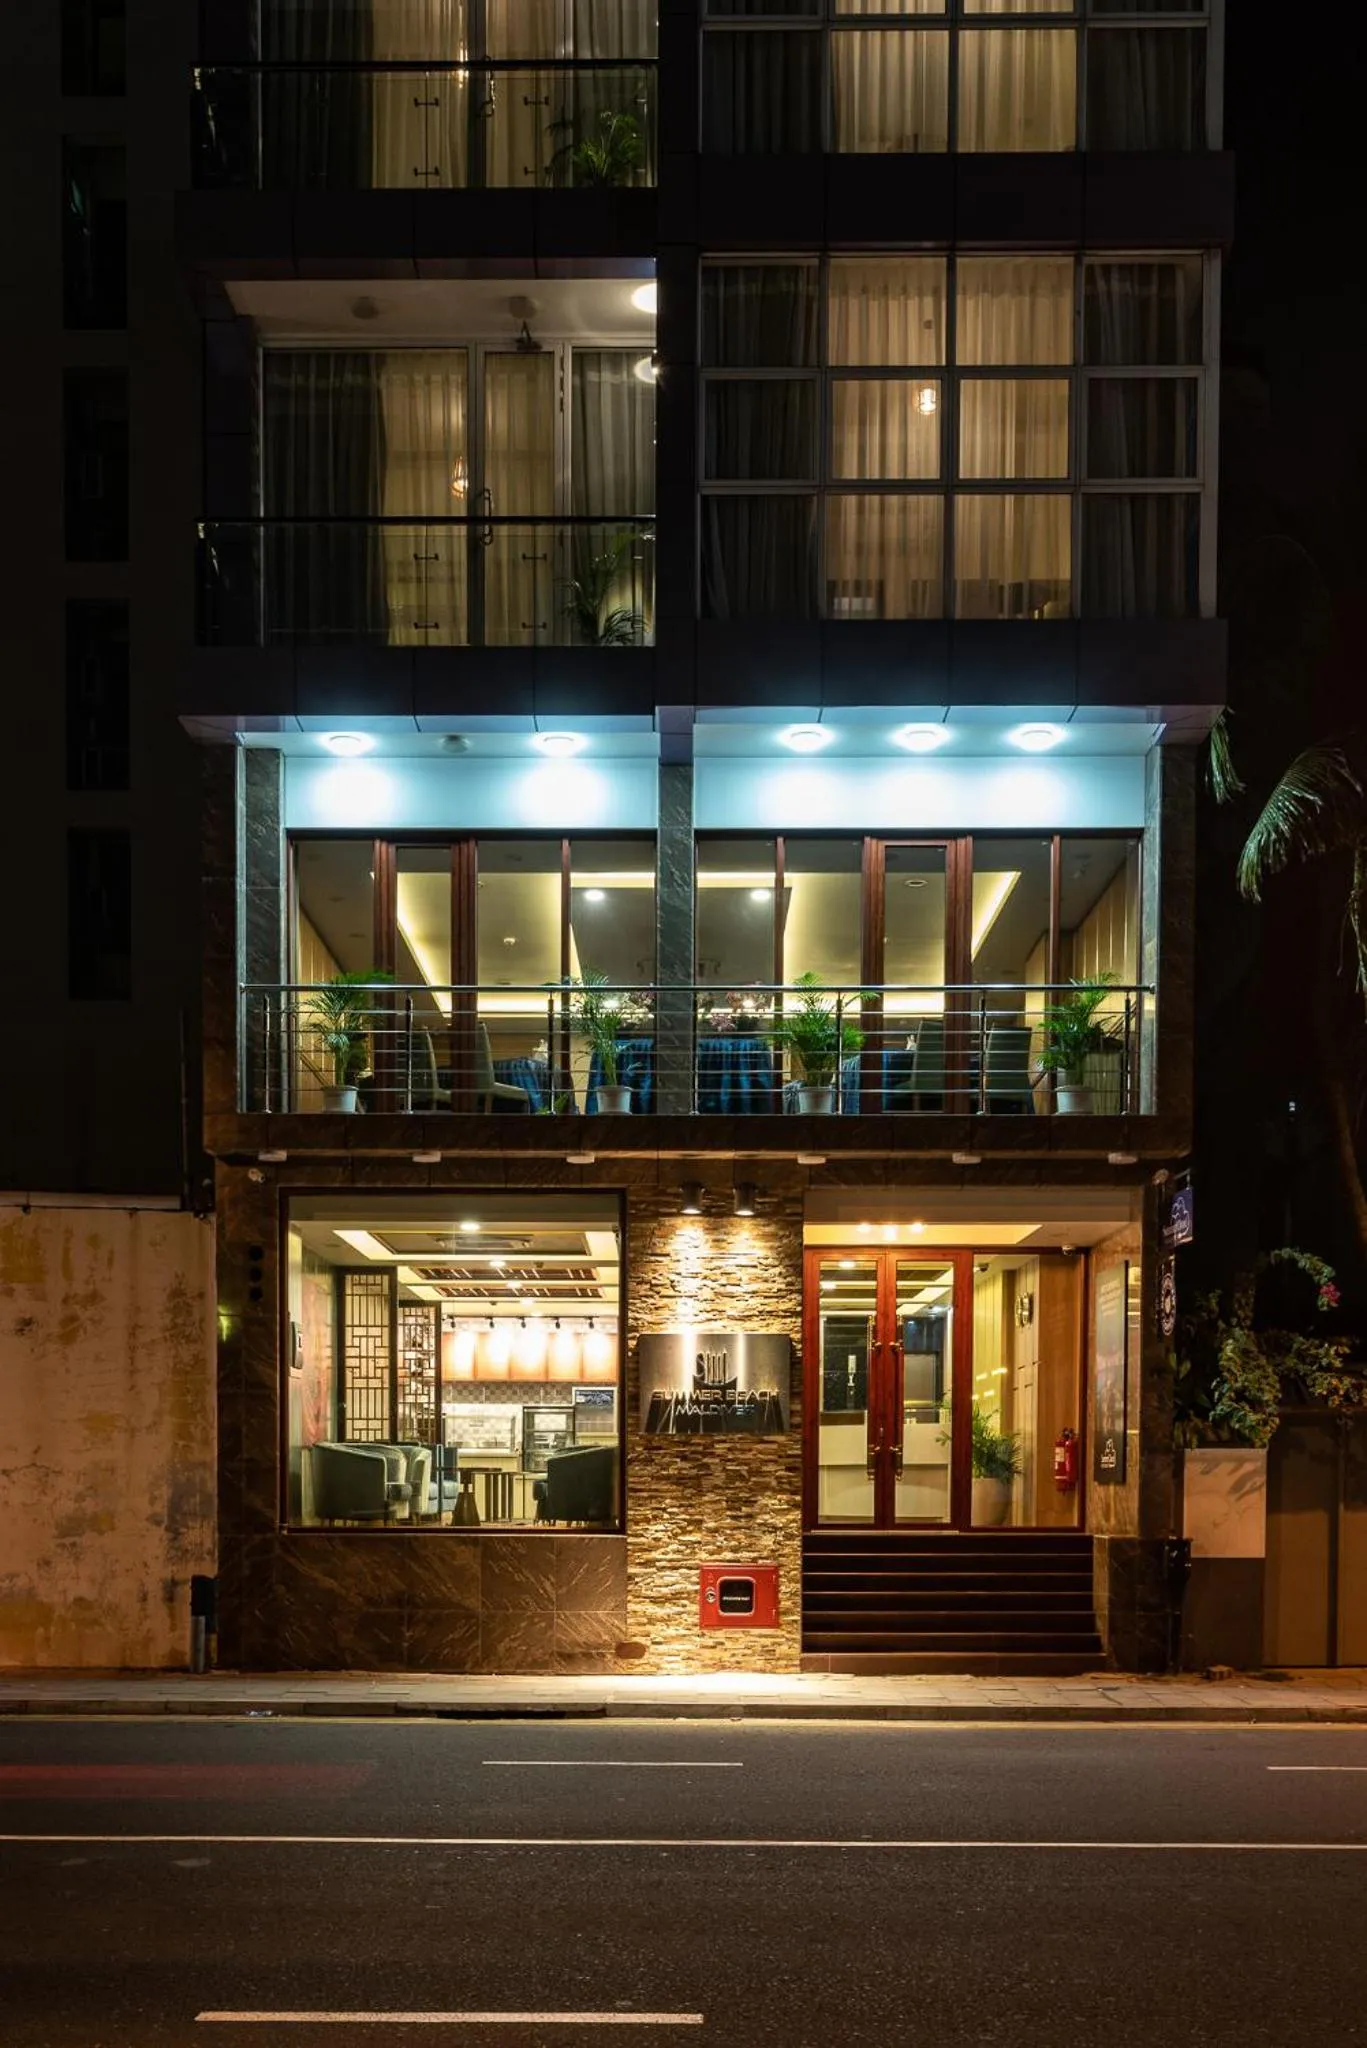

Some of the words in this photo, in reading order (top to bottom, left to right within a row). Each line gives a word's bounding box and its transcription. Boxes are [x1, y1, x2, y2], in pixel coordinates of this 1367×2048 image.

[651, 1389, 723, 1400] SUMMER
[726, 1389, 779, 1400] BEACH
[675, 1404, 755, 1416] MALDIVES
